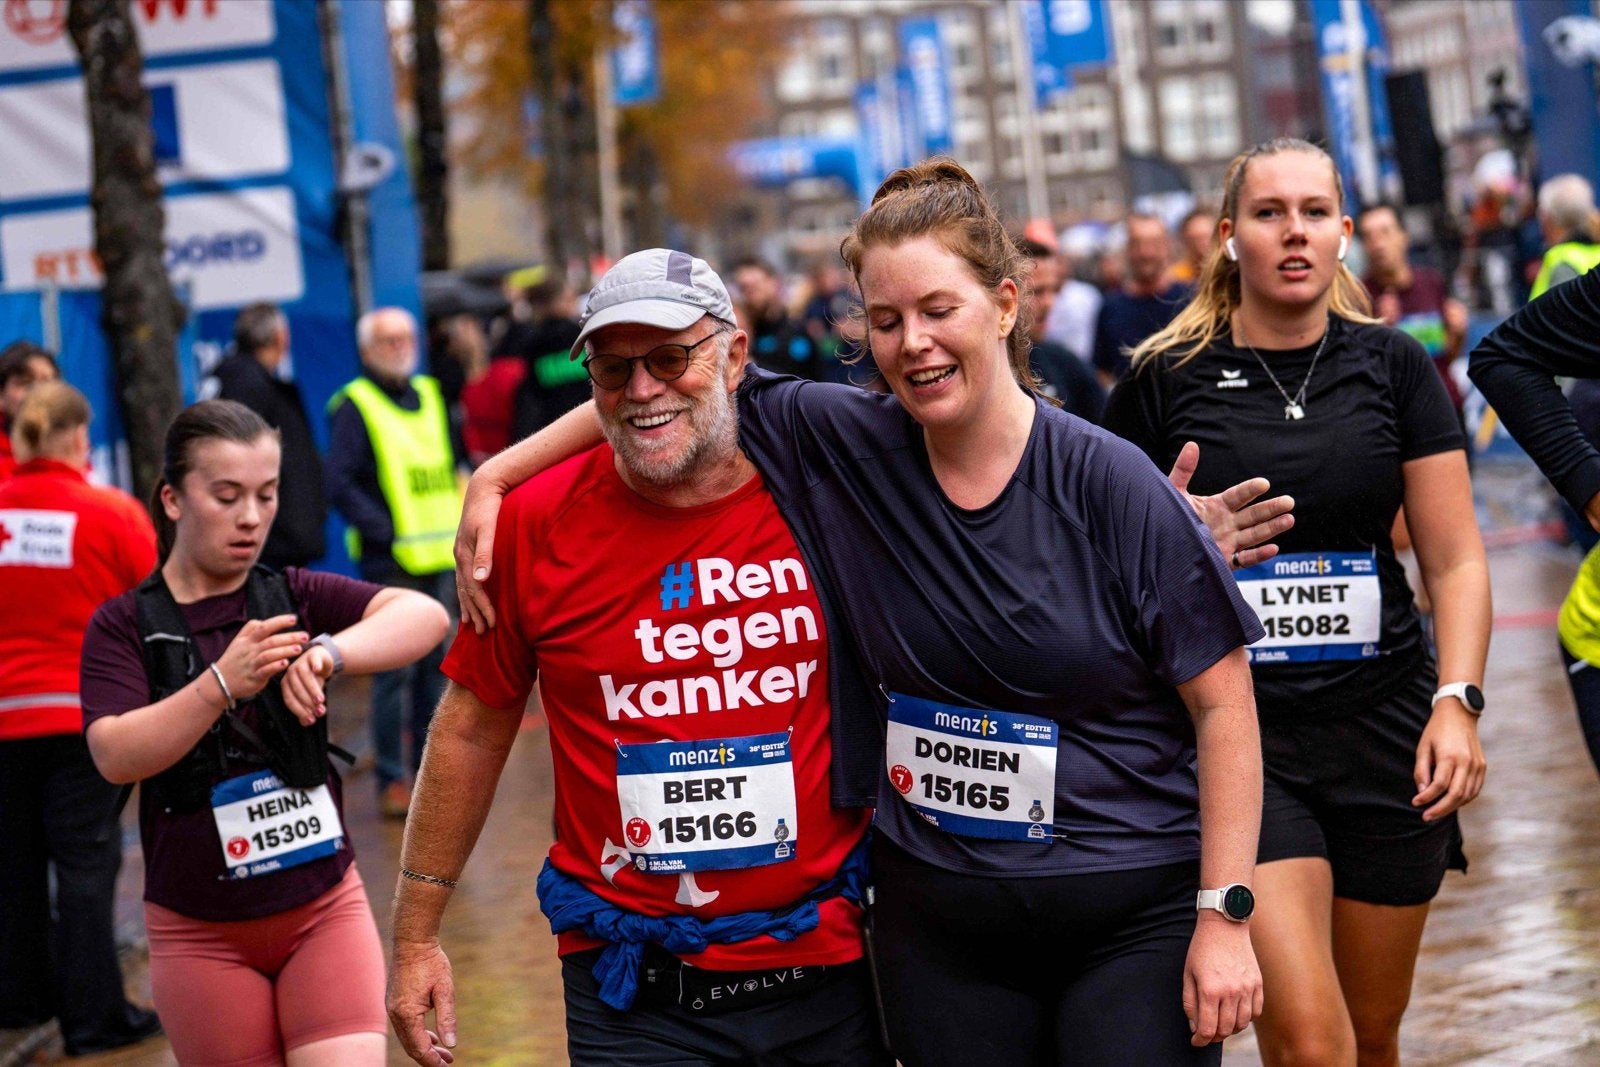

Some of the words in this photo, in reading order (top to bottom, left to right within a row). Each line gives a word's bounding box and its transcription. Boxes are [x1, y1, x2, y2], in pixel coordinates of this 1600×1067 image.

[1274, 555, 1332, 575] menzis
[659, 557, 808, 611] #Ren
[1261, 584, 1349, 606] LYNET
[634, 604, 819, 668] tegen
[1263, 614, 1350, 638] 15082
[599, 659, 818, 721] kanker
[935, 711, 998, 736] menzis
[1025, 724, 1052, 733] EDITIE
[669, 742, 736, 766] menzis
[761, 742, 785, 751] EDITIE
[915, 736, 1020, 774] DORIEN
[663, 775, 747, 804] BERT
[896, 773, 905, 786] 7
[920, 773, 1010, 811] 15165
[246, 791, 312, 822] HEINA
[251, 816, 321, 851] 15309
[632, 826, 641, 839] 7
[658, 811, 757, 844] 15166
[711, 966, 804, 999] EVOLVE
